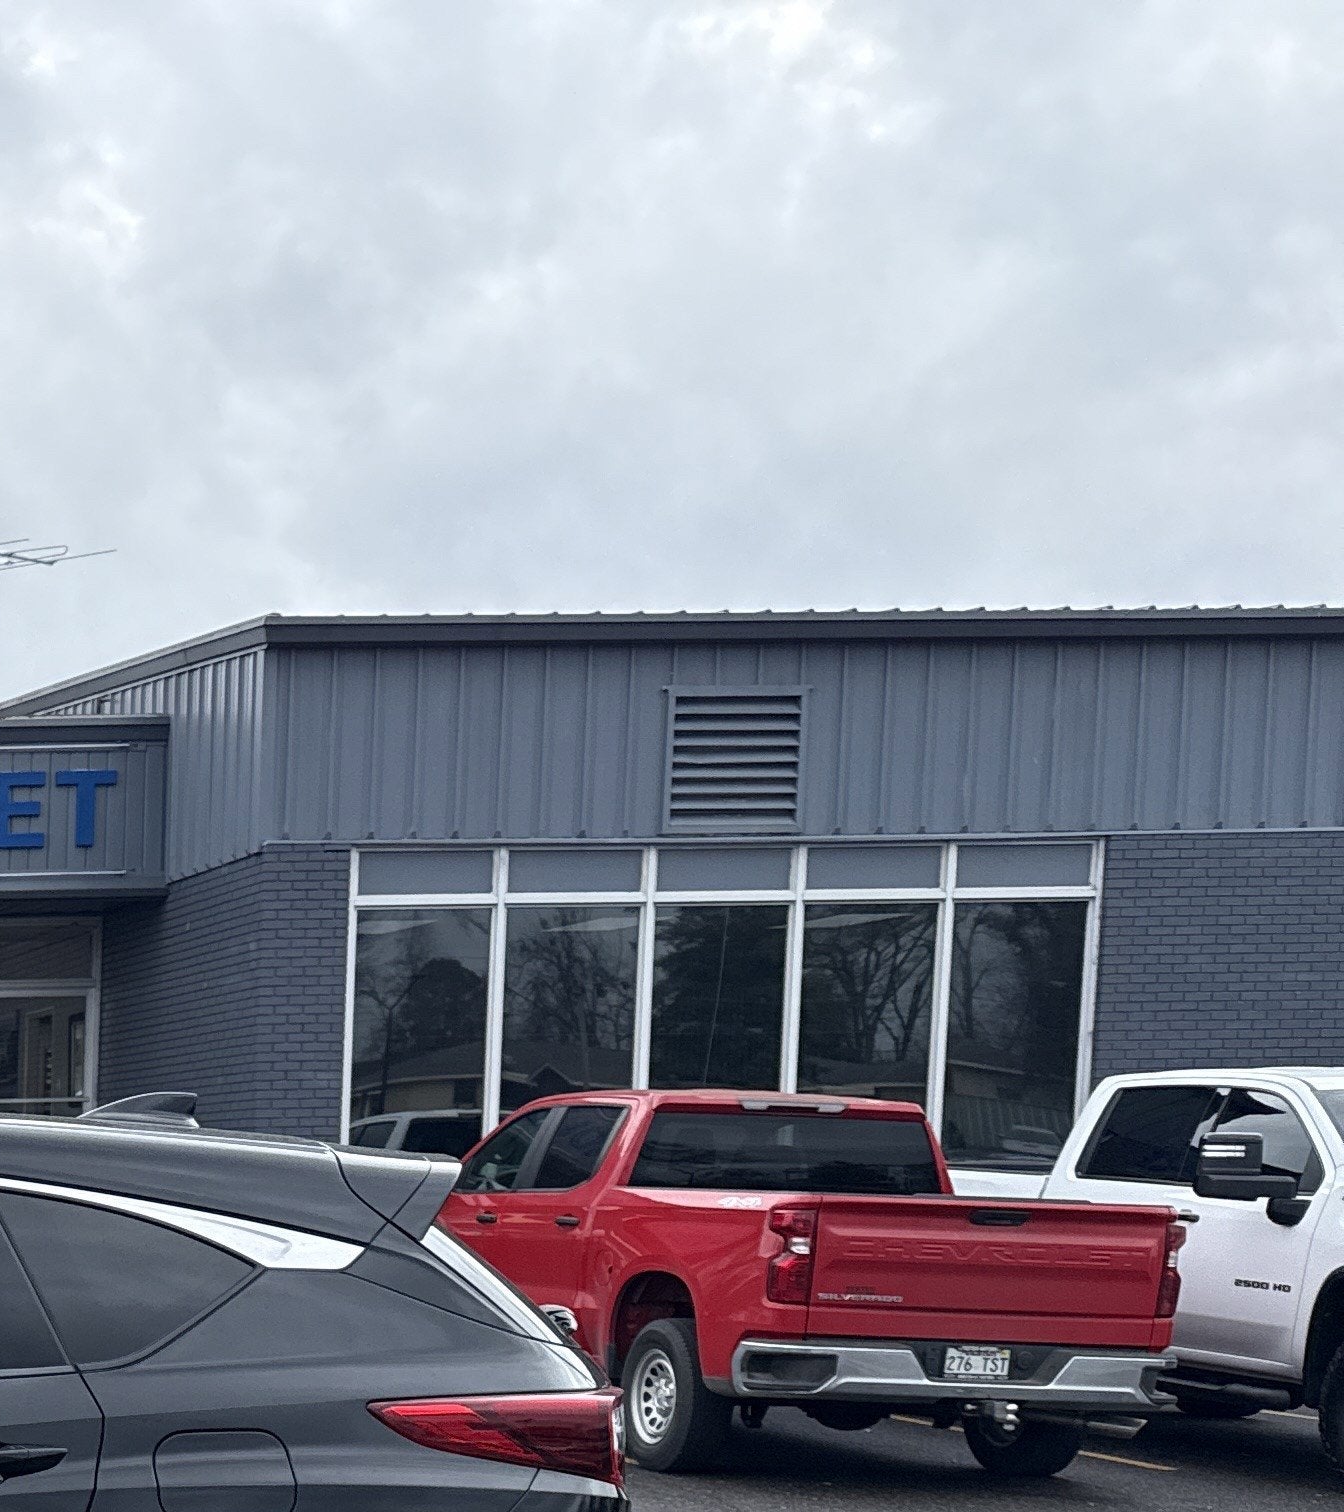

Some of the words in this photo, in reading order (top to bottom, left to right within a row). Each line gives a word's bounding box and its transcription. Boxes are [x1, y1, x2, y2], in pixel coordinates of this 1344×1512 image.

[843, 1239, 1152, 1267] CHEVROLET
[1234, 1279, 1269, 1290] 2500
[1273, 1283, 1291, 1293] HD
[817, 1292, 904, 1303] SILVERADO
[946, 1356, 972, 1371] 276
[982, 1357, 1009, 1373] TST
